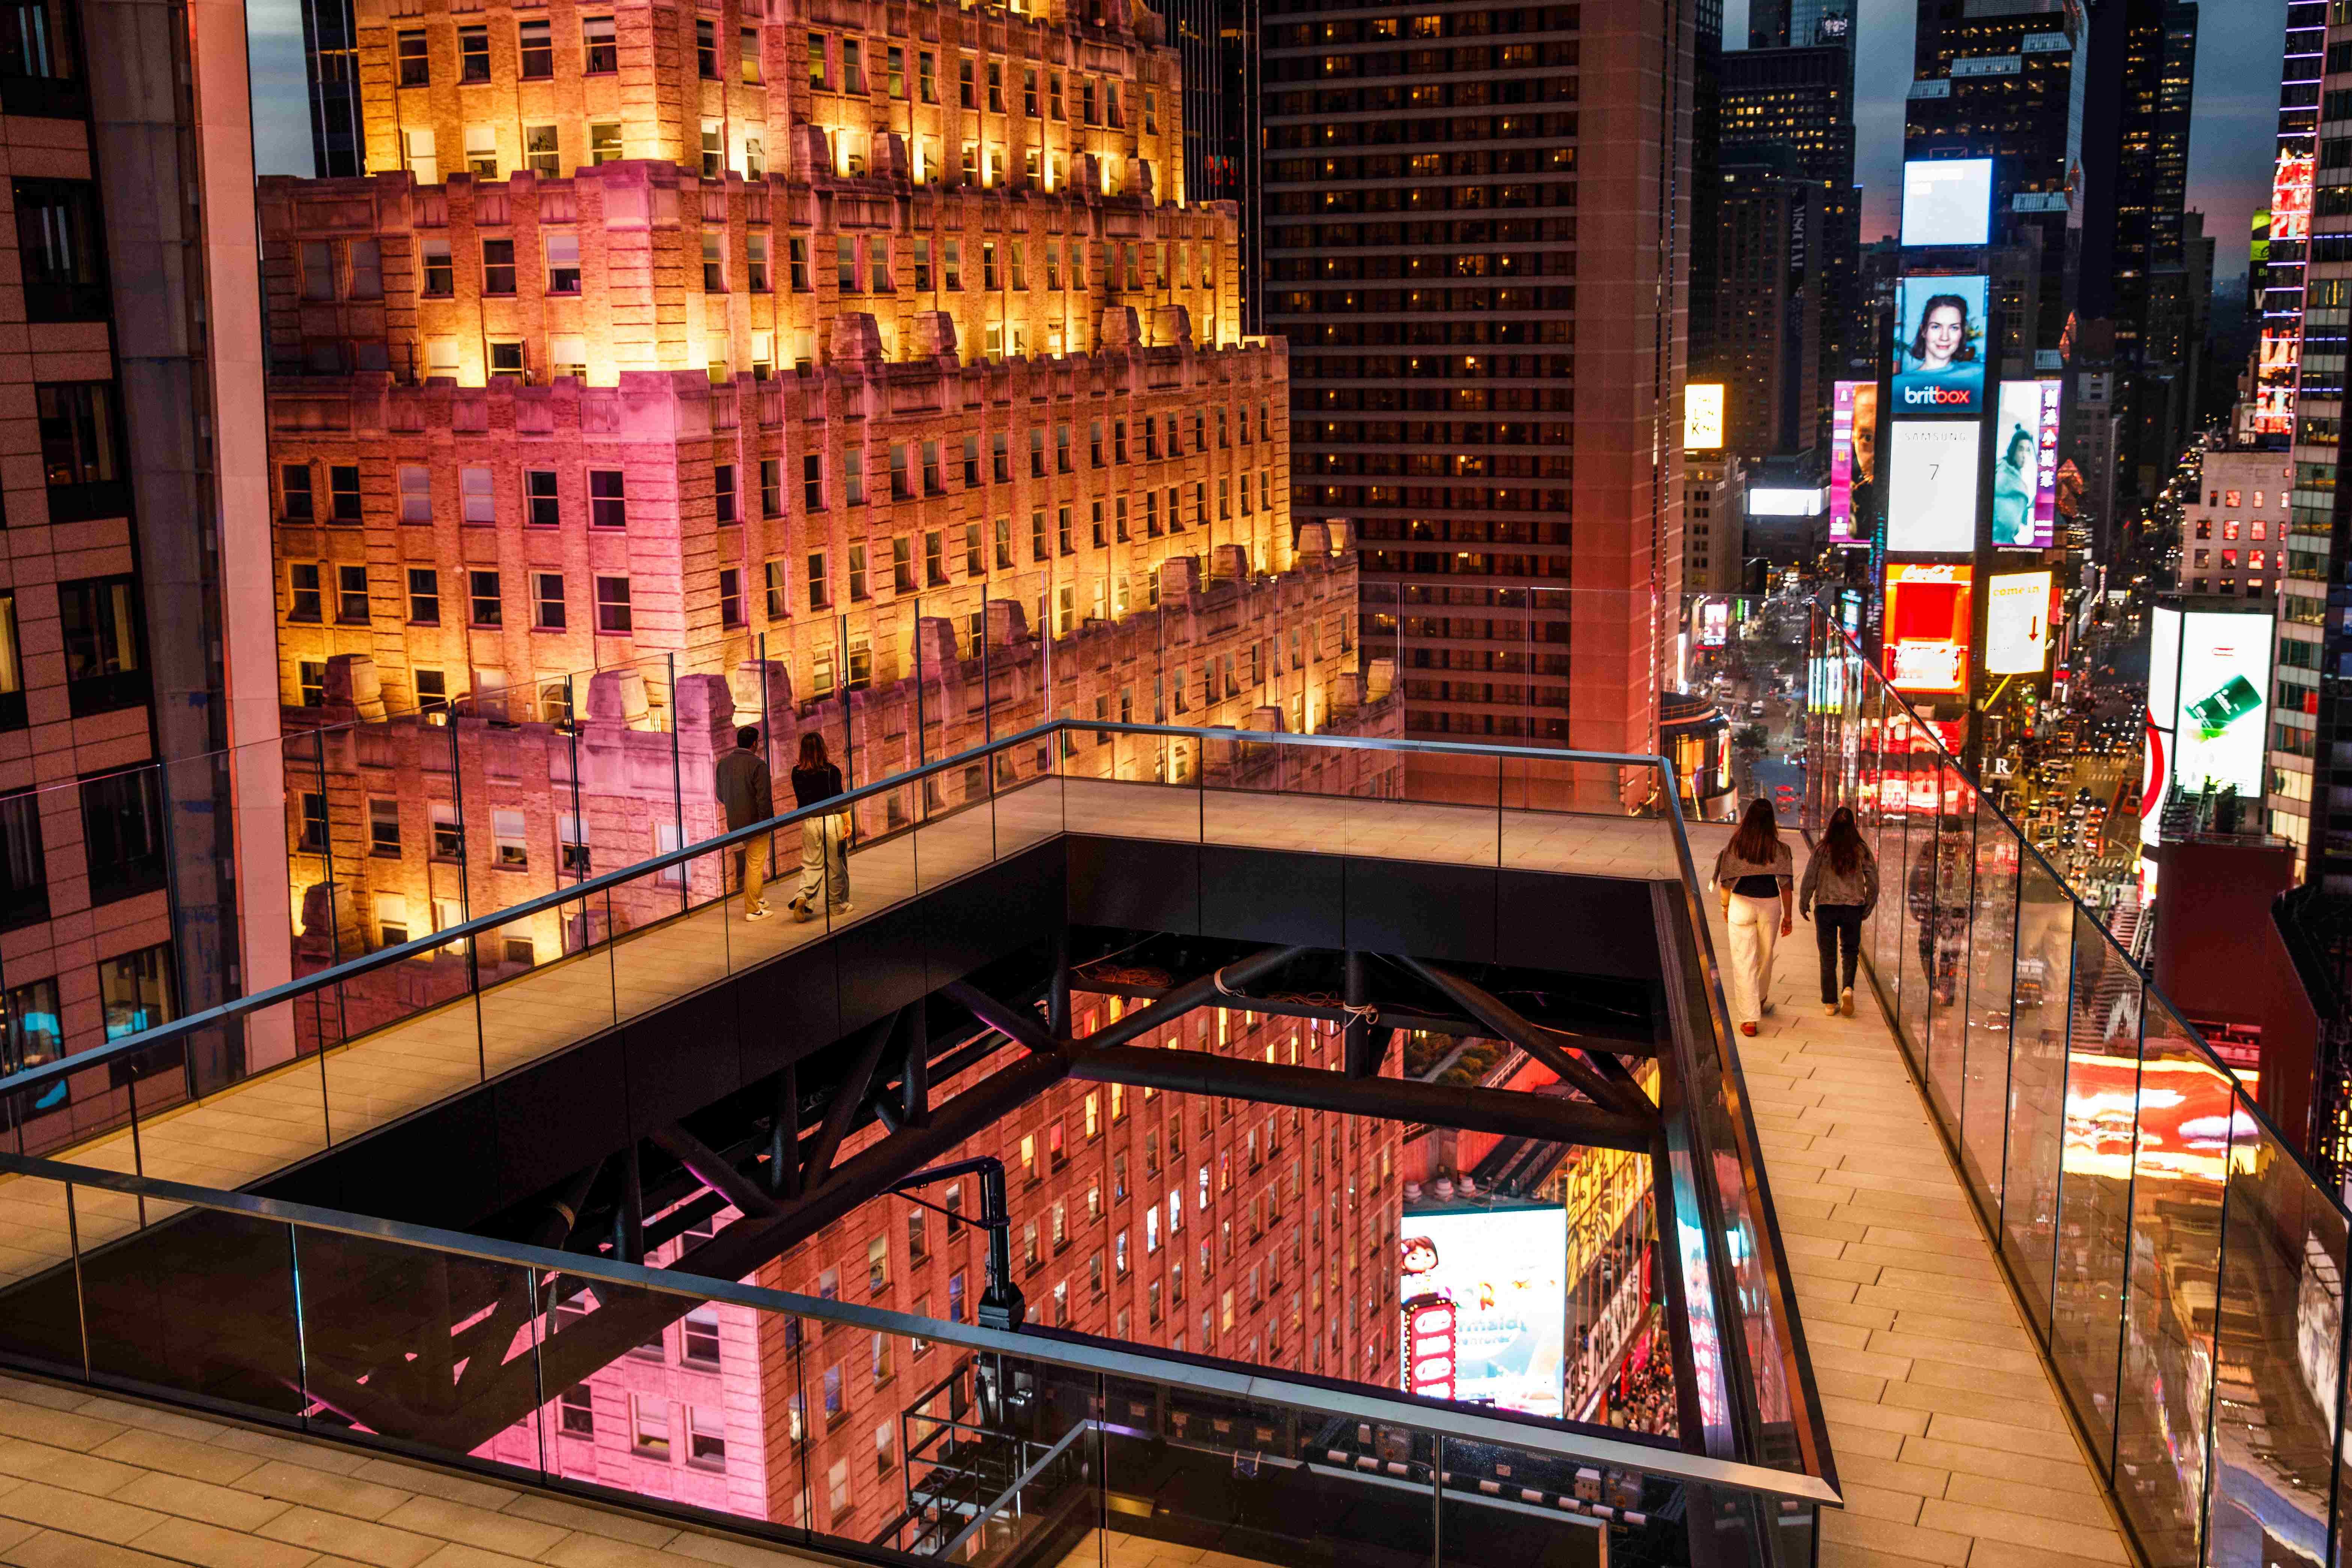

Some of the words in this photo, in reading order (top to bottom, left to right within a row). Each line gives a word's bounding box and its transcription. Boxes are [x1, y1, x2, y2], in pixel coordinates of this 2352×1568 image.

[1905, 386, 1971, 404] britbox
[1904, 433, 1966, 441] SAMSUNG
[1929, 464, 1939, 480] 7
[1993, 588, 2025, 596] come
